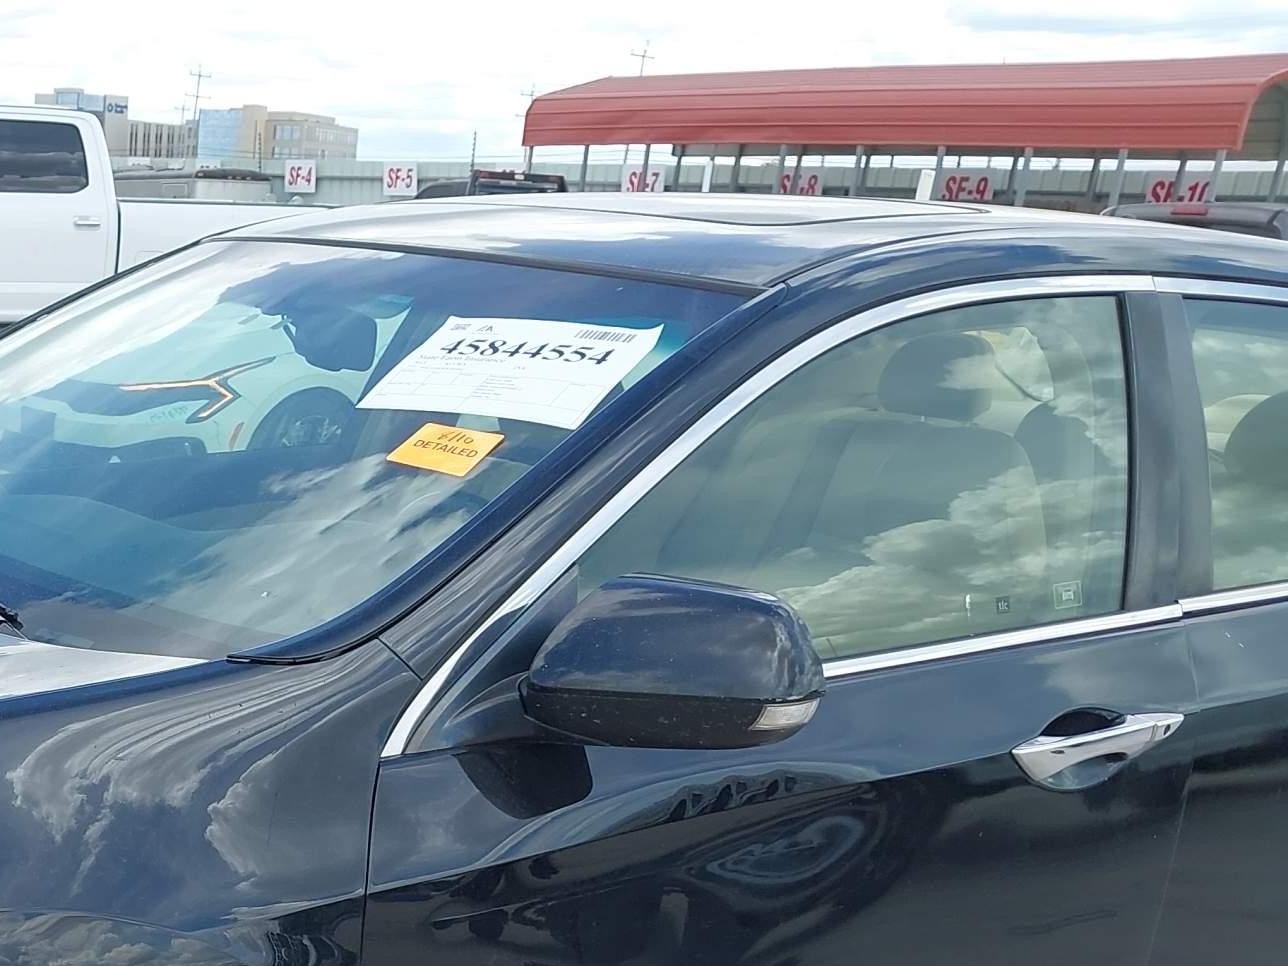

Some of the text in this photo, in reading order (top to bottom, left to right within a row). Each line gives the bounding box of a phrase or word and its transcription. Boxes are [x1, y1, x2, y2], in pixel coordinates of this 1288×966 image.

[288, 166, 312, 186] SF-4
[387, 168, 413, 188] SF-5
[781, 174, 818, 194] S-8
[943, 175, 988, 200] SF-9
[440, 338, 615, 366] 45844554
[413, 439, 479, 458] DETAILED
